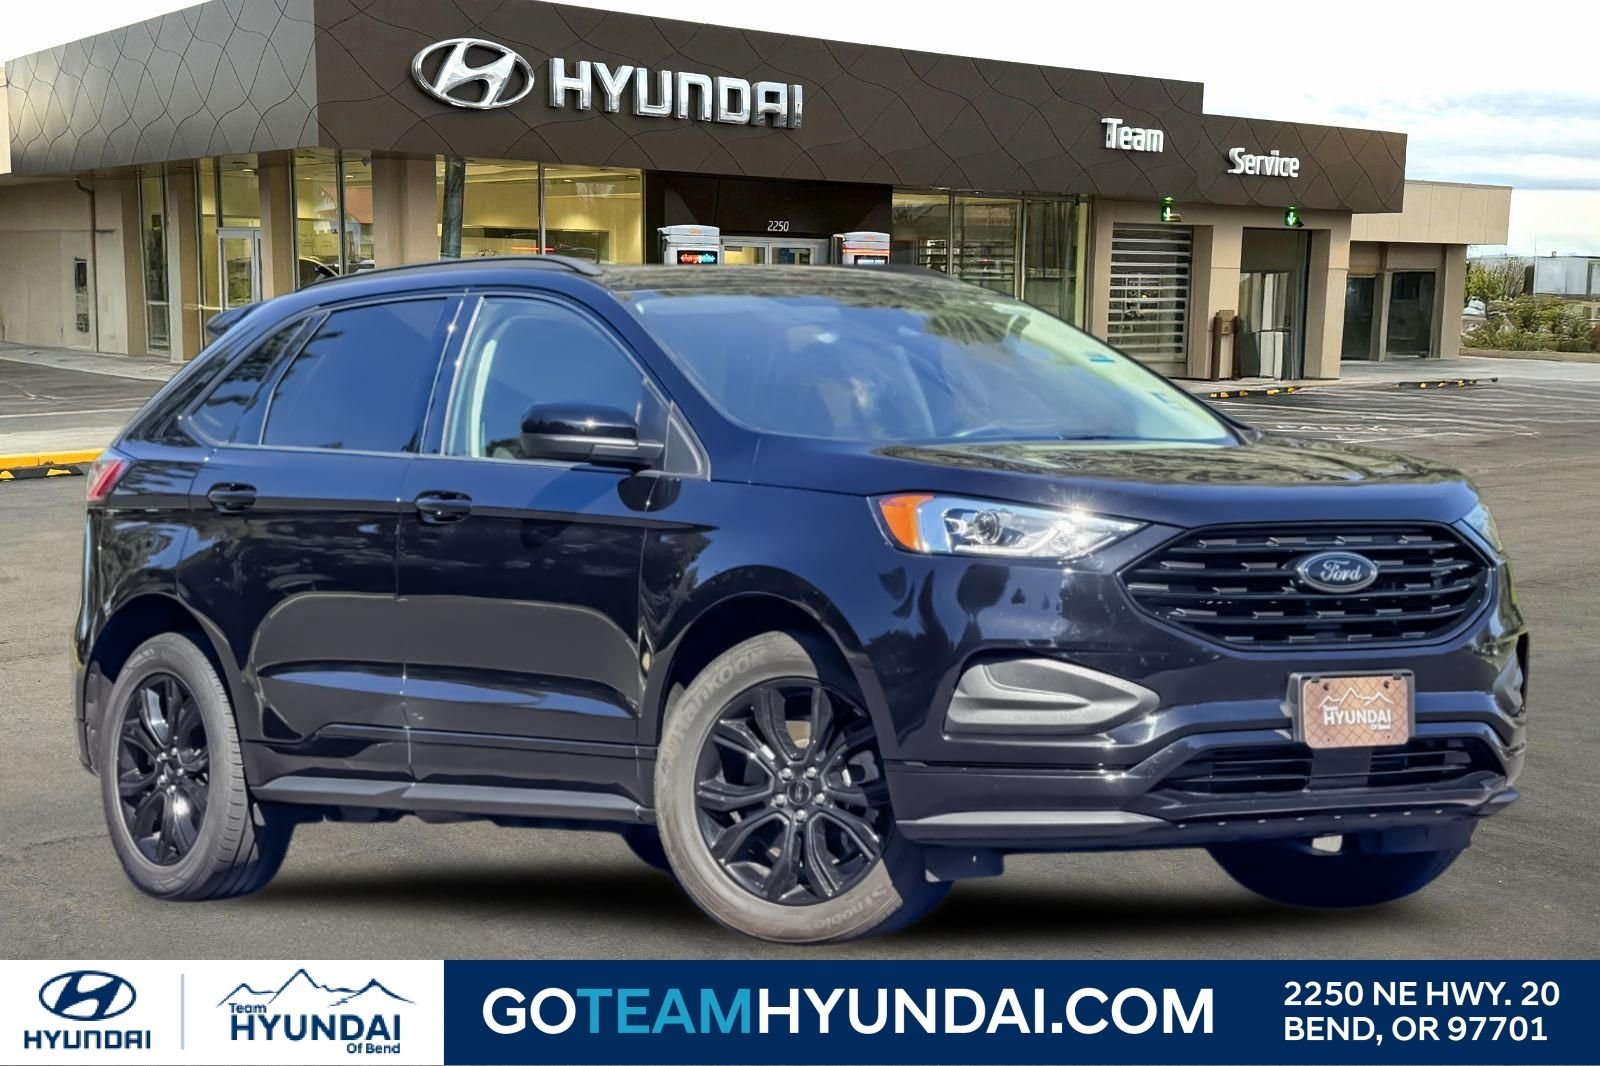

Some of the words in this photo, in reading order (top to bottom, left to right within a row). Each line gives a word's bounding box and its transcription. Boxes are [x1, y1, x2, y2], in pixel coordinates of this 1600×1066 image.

[548, 57, 803, 128] HYUNDAI
[1101, 118, 1164, 153] Team
[1227, 147, 1300, 178] Service
[767, 220, 789, 232] 2250
[1320, 560, 1362, 582] Ford
[1324, 709, 1392, 726] HYUNDAI
